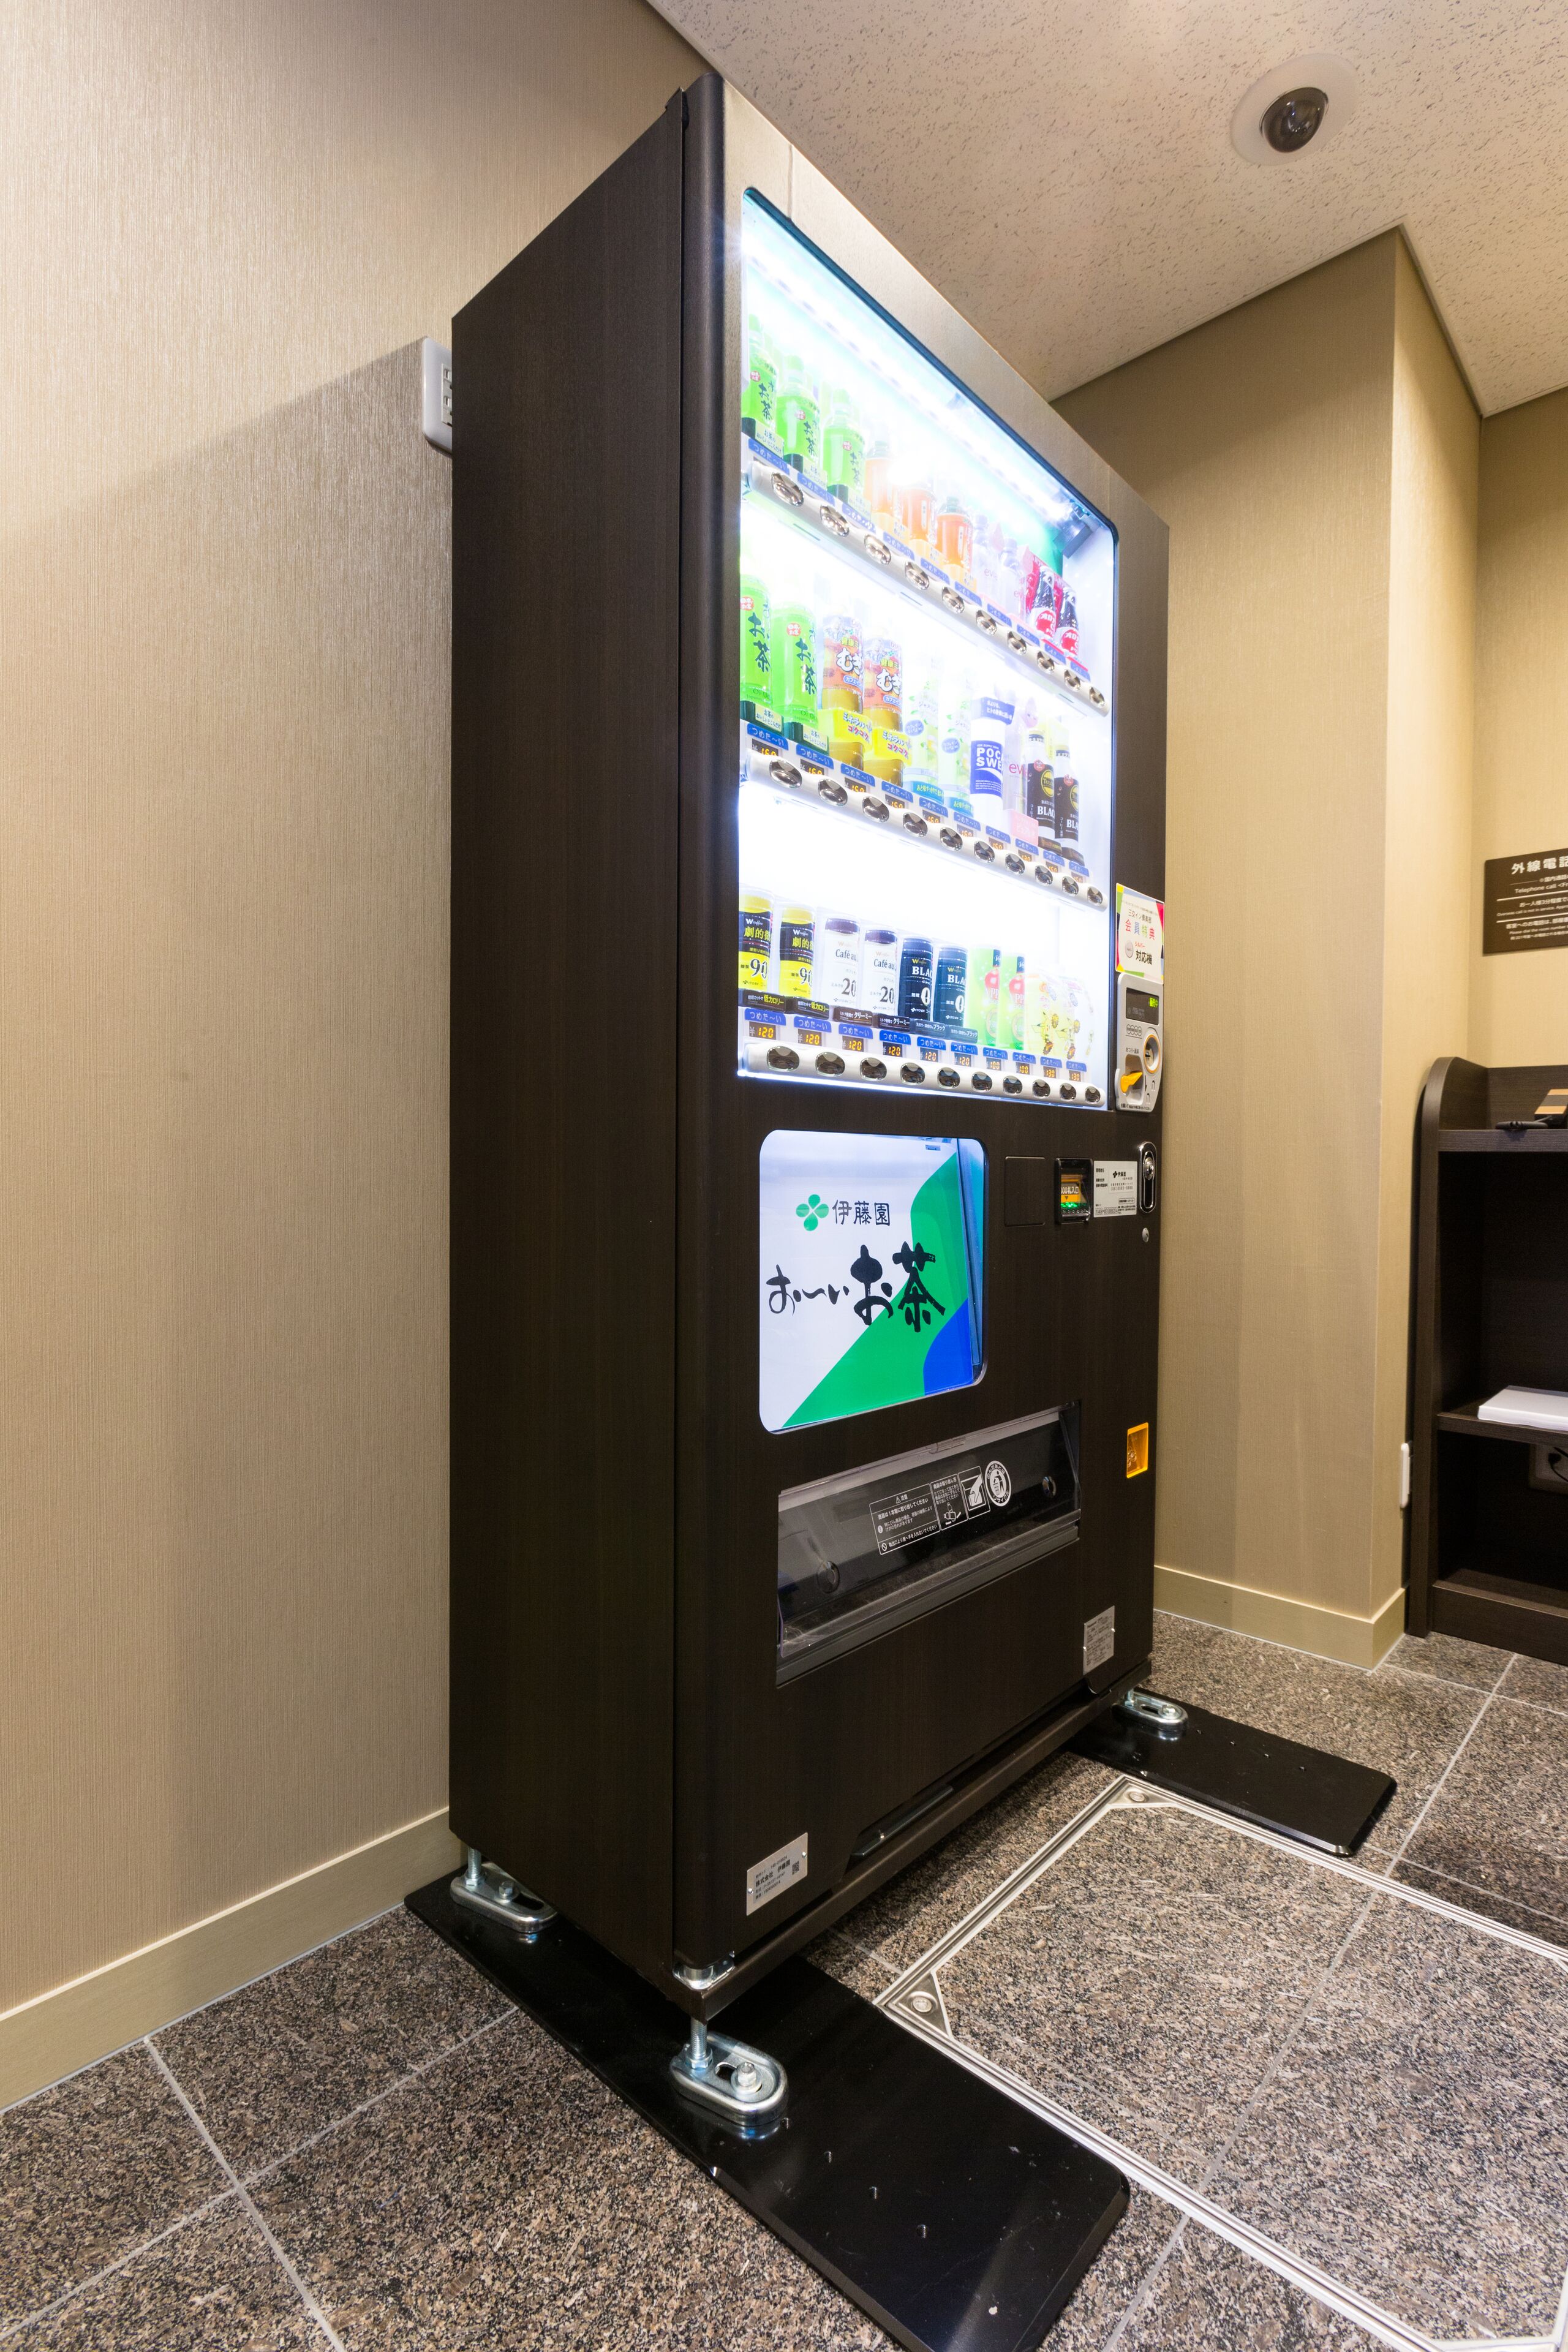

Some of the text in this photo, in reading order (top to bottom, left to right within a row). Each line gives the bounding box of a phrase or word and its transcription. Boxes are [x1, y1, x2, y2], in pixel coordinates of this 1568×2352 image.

[748, 612, 771, 673] お茶
[796, 638, 817, 695] お茶
[752, 728, 785, 746] つめた〜い
[801, 748, 830, 766] つめた〜い
[845, 767, 873, 784] つめた〜い
[1125, 919, 1156, 941] 会員特典
[835, 949, 850, 959] Café
[1136, 949, 1153, 965] 対応機
[873, 959, 888, 968] Café
[842, 978, 856, 997] 20
[880, 986, 894, 1004] 20
[750, 1012, 782, 1022] つめた〜い
[798, 1019, 827, 1030] つめた〜い
[758, 1027, 774, 1038] 120
[842, 1027, 870, 1036] つめた〜い
[805, 1034, 820, 1045] 120
[883, 1033, 908, 1042] つめた〜い
[849, 1040, 862, 1051] 120
[921, 1039, 943, 1049] つめた〜い
[889, 1046, 901, 1056] 120
[925, 1052, 937, 1061] 120
[959, 1057, 970, 1066] 120
[990, 1061, 1000, 1070] 100
[832, 1199, 891, 1226] 伊藤園
[756, 1871, 774, 1888] 株式会社
